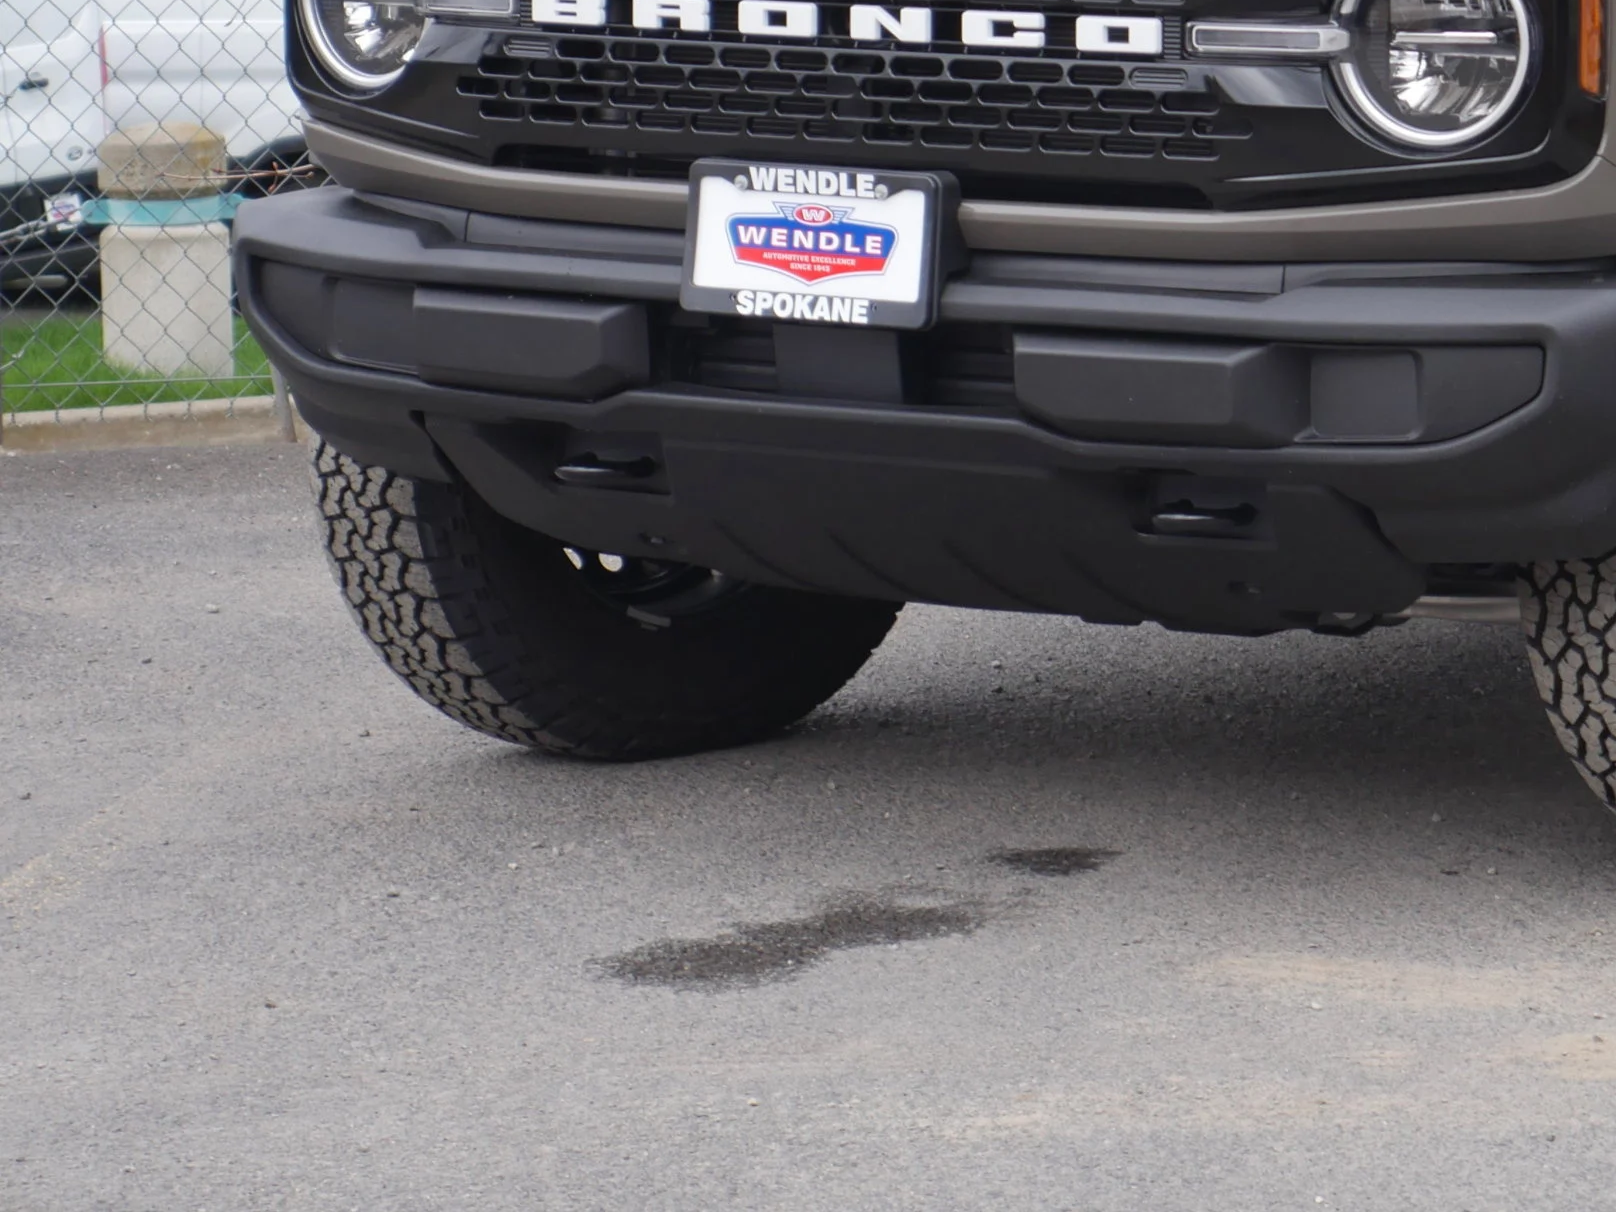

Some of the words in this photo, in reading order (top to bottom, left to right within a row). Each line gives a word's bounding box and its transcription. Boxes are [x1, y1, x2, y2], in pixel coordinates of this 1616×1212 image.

[749, 166, 877, 199] WENDLE
[737, 225, 883, 255] WENDLE
[763, 251, 810, 263] AUTOMOTIVE
[811, 255, 856, 266] EXCELLENCE
[790, 262, 812, 272] SINCE
[813, 264, 831, 273] 1943
[736, 289, 869, 324] SPOKANE
